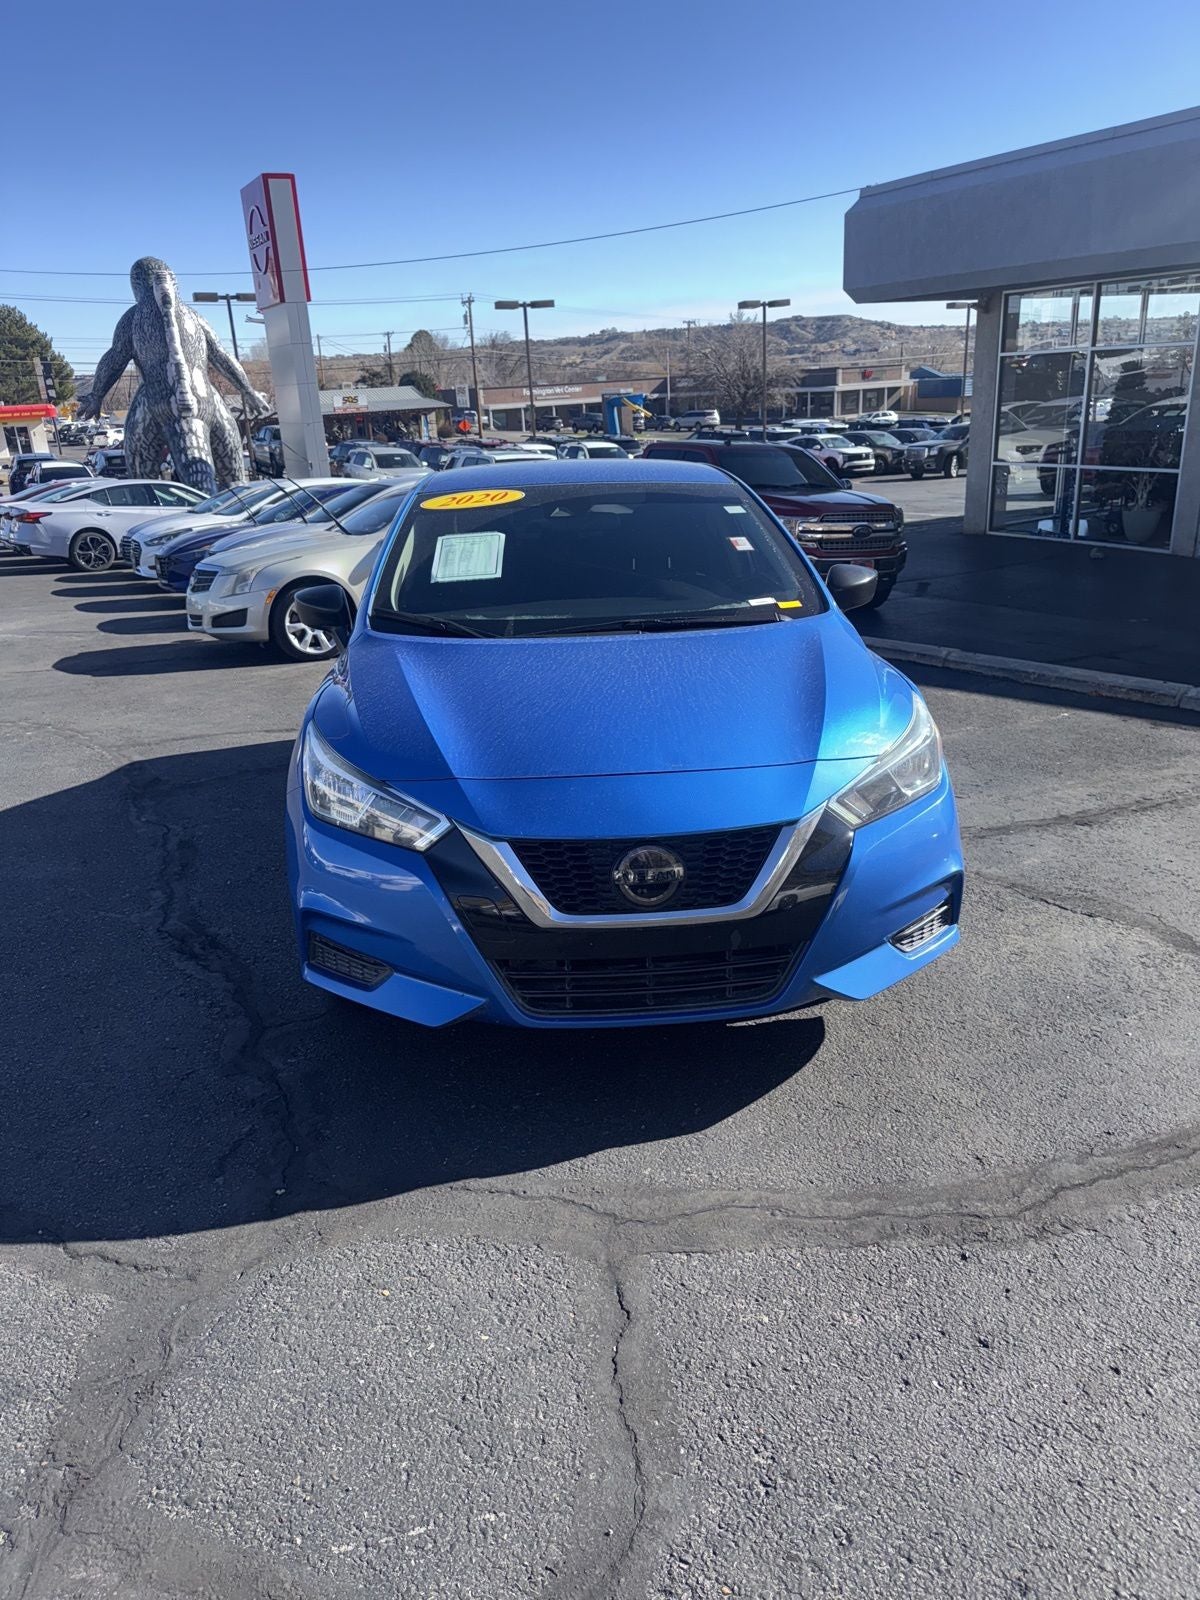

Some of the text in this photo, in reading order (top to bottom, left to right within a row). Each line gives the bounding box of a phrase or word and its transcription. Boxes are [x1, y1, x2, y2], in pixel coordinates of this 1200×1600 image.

[249, 231, 269, 250] NISSAN
[523, 387, 554, 396] Famington
[437, 491, 508, 507] 2020
[614, 863, 684, 884] NISSAN
